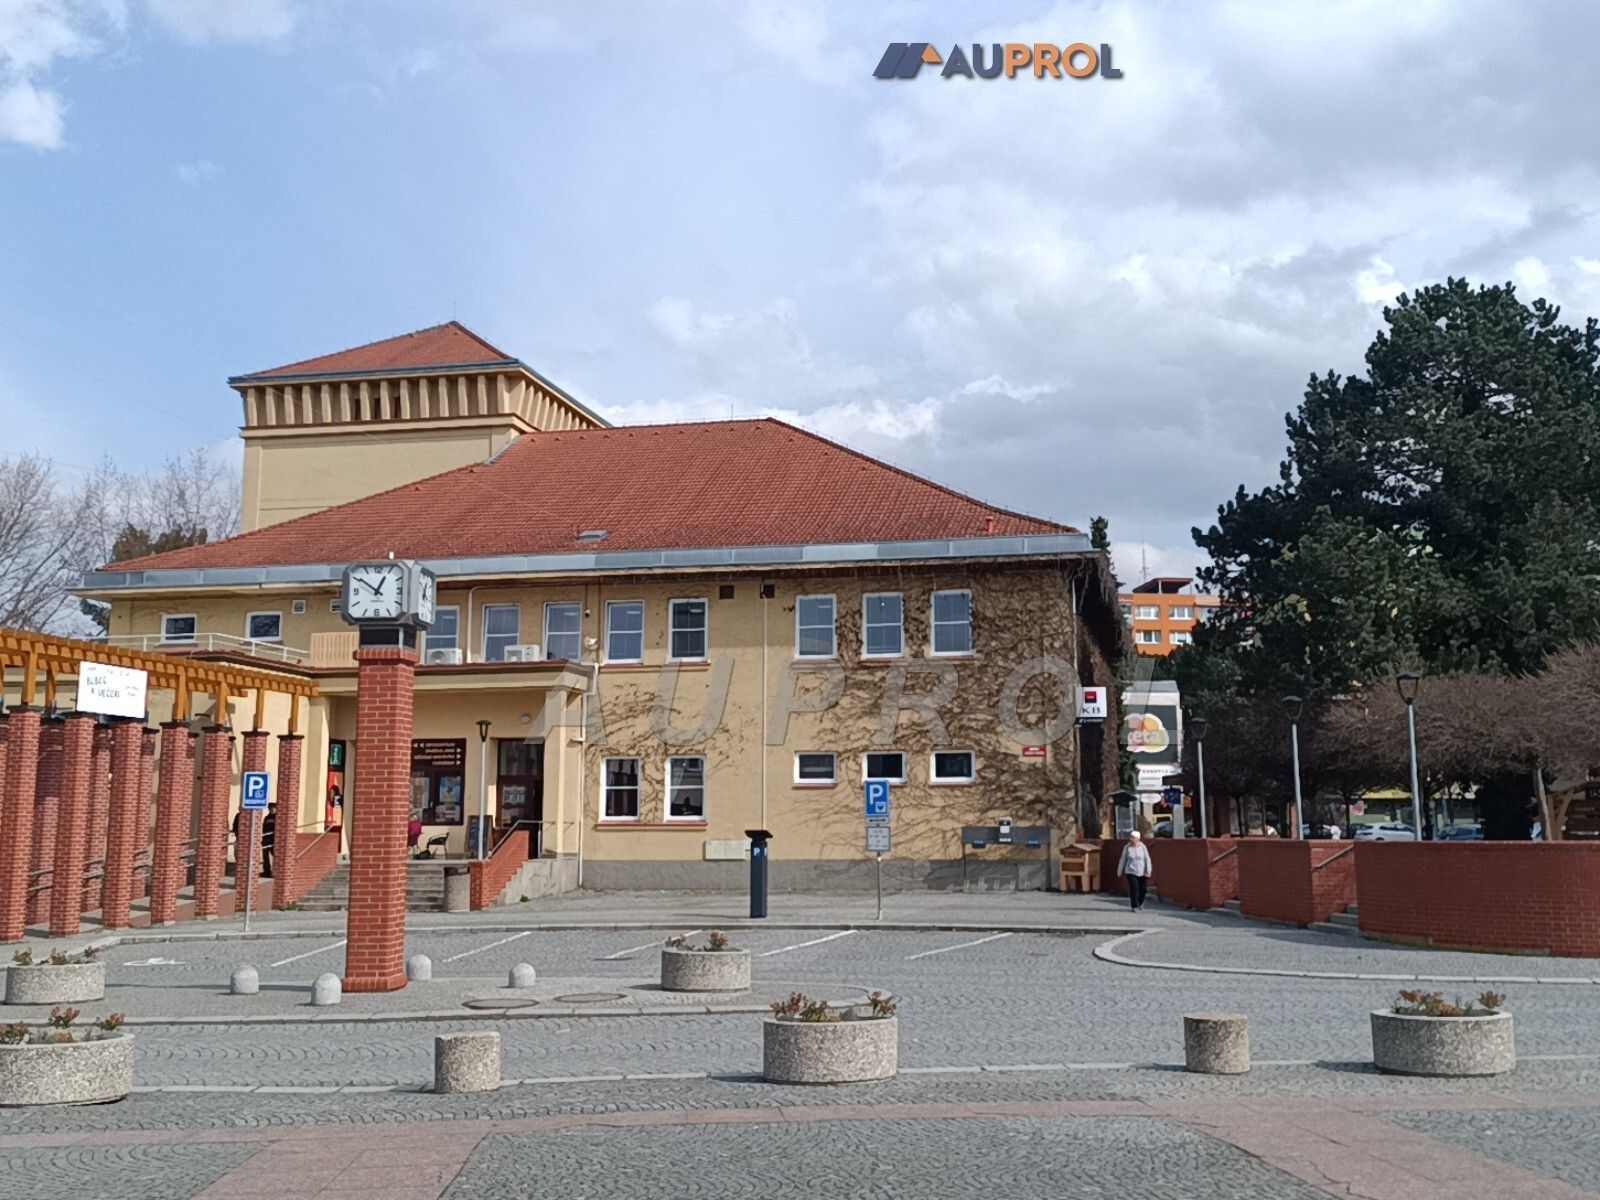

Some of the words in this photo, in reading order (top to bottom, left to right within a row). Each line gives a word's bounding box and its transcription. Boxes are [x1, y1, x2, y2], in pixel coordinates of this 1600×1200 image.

[373, 566, 383, 574] 12
[353, 587, 359, 596] 9
[396, 587, 402, 596] 3
[373, 608, 380, 617] 6
[1082, 706, 1101, 714] KB
[248, 776, 264, 798] P
[869, 784, 883, 805] P
[753, 847, 760, 857] P
